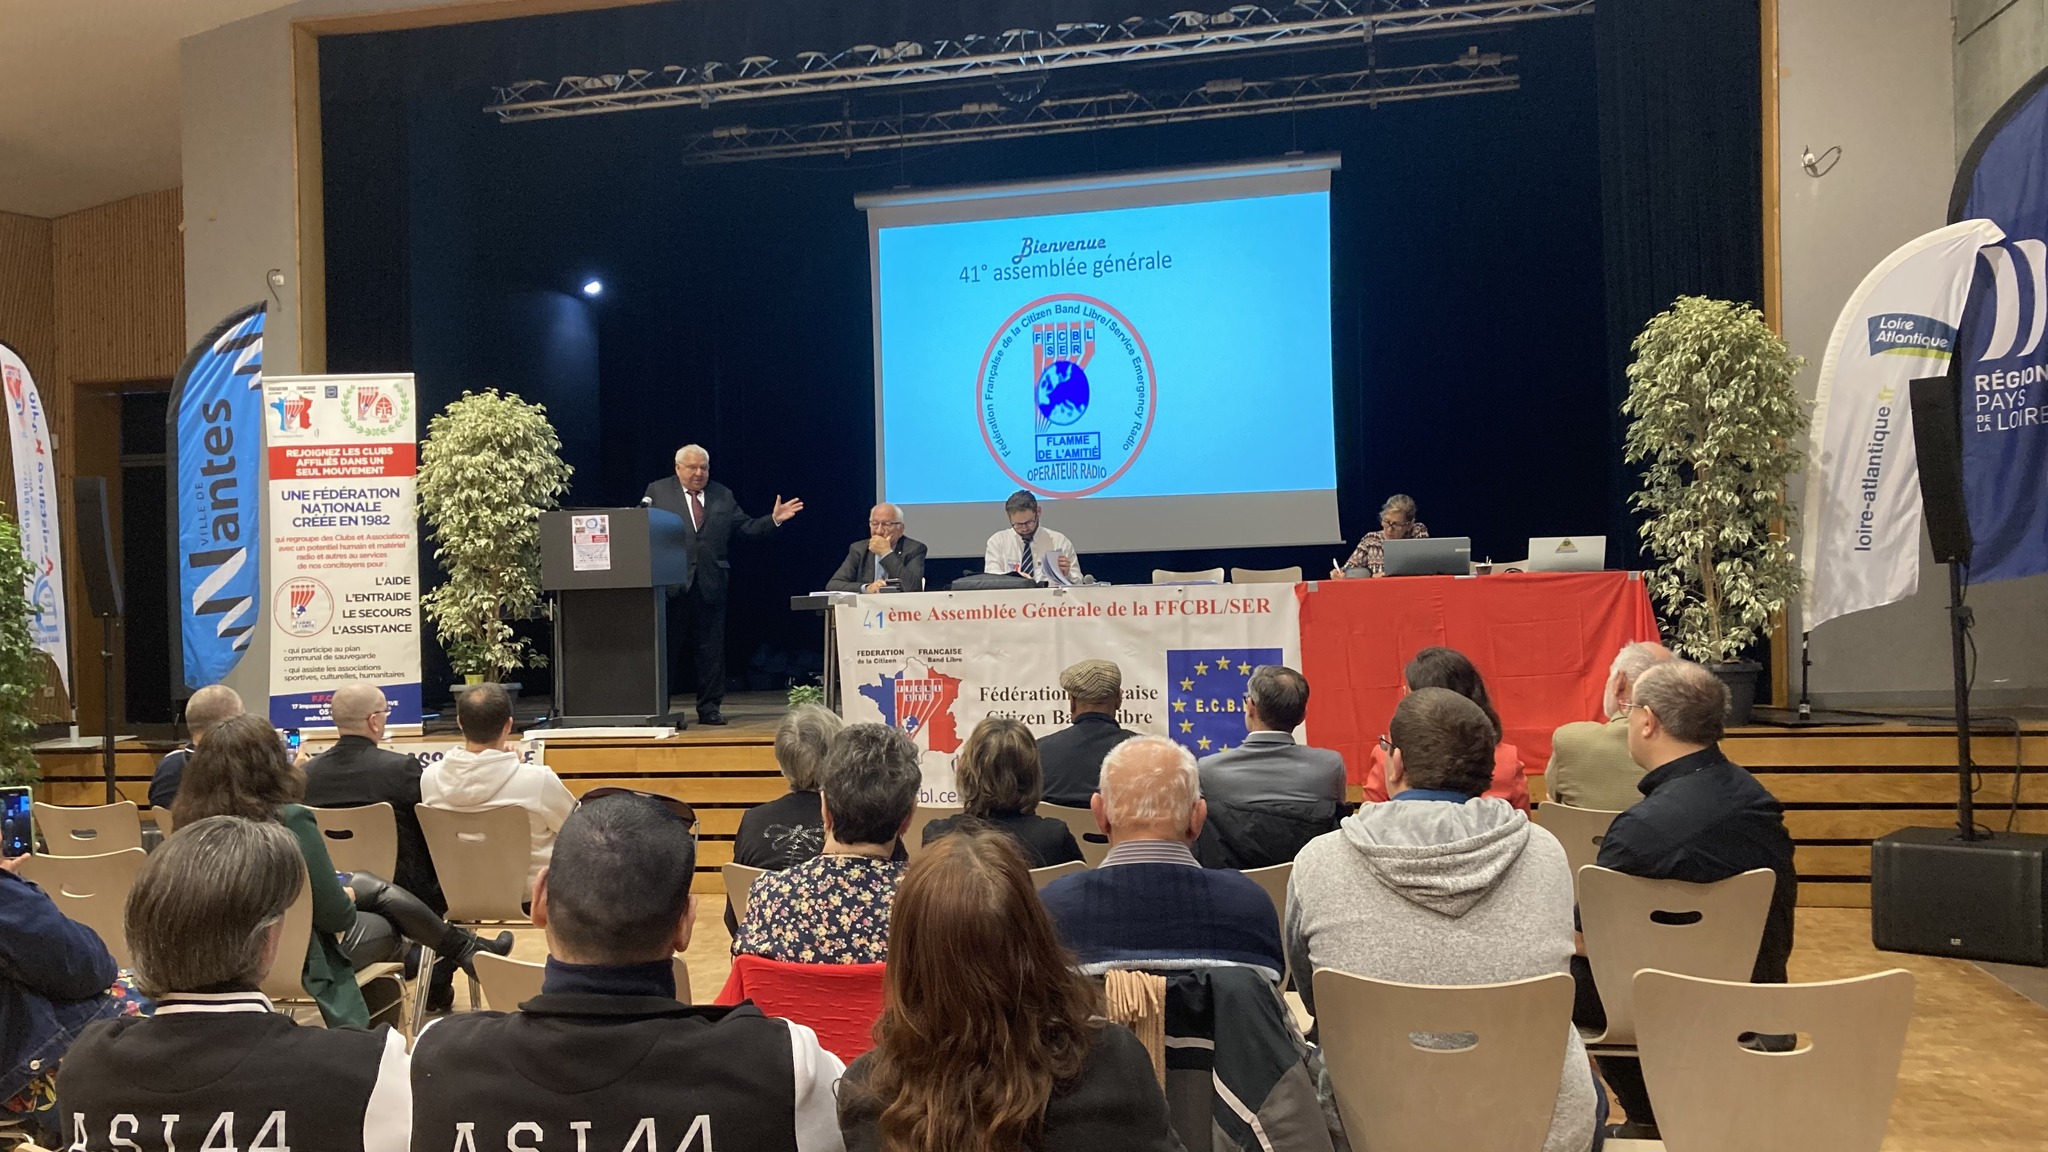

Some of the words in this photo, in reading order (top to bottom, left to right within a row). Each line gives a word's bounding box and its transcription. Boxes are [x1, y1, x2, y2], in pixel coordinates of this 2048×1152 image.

[1012, 237, 1106, 264] Bienvenue
[993, 257, 1087, 282] assemblée
[1092, 251, 1172, 278] générale
[1055, 304, 1080, 314] Band
[1021, 308, 1052, 328] Citizen
[1879, 316, 1915, 331] Loire
[1011, 326, 1022, 337] la
[1003, 336, 1013, 349] de
[1876, 331, 1948, 349] Atlantique
[985, 350, 1004, 400] Française
[1975, 364, 2048, 391] RÉGION
[1131, 356, 1146, 419] Emergency
[1976, 388, 2026, 412] PAYS
[1976, 414, 1991, 423] DE
[1998, 405, 2048, 431] LOIRE
[986, 404, 1011, 458] Fédération
[1977, 423, 1992, 433] LA
[1046, 435, 1090, 446] FLAMME
[1122, 421, 1143, 452] Radio
[286, 448, 341, 458] REJOIGNEZ
[342, 447, 360, 456] LES
[362, 446, 394, 456] CLUBS
[1038, 449, 1051, 459] DE
[1055, 446, 1099, 459] L'AMITIÉ
[296, 457, 339, 467] AFFILIÉS
[340, 457, 368, 466] DANS
[369, 456, 384, 465] UN
[295, 467, 321, 477] SEUL
[322, 466, 385, 476] MOUVEMENT
[1027, 462, 1079, 482] OPERATEUR
[1080, 461, 1107, 480] RADIO
[1855, 386, 1895, 551] loire-atlantique.fr
[194, 482, 204, 499] DE
[281, 490, 311, 501] UNE
[313, 486, 400, 500] FÉDÉRATION
[301, 502, 382, 514] NATIONALE
[197, 503, 208, 546] VILLE
[292, 513, 337, 528] CRÉÉE
[339, 516, 359, 526] EN
[361, 515, 390, 526] 1982
[275, 535, 285, 543] qui
[286, 536, 319, 544] regroupe
[321, 534, 333, 542] des
[307, 544, 338, 552] potentiel
[323, 562, 366, 570] concitoyens
[375, 576, 411, 586] L'AIDE
[345, 592, 412, 603] L'ENTRAIDE
[342, 609, 356, 618] LE
[358, 608, 412, 618] SECOURS
[927, 604, 1017, 621] Assemblée
[1022, 601, 1101, 619] Générale
[1106, 601, 1128, 617] de
[1132, 600, 1148, 616] la
[1155, 597, 1272, 616] FFCBL/SER
[332, 624, 412, 635] L'ASSISTANCE
[301, 646, 332, 654] participe
[345, 645, 360, 653] plan
[856, 649, 905, 657] FEDERATION
[284, 654, 322, 662] communal
[334, 653, 376, 661] sauvegarde
[284, 674, 319, 682] sportives,
[320, 672, 358, 681] culturelles,
[359, 671, 405, 679] humanitaires
[1117, 709, 1153, 724] ibre
